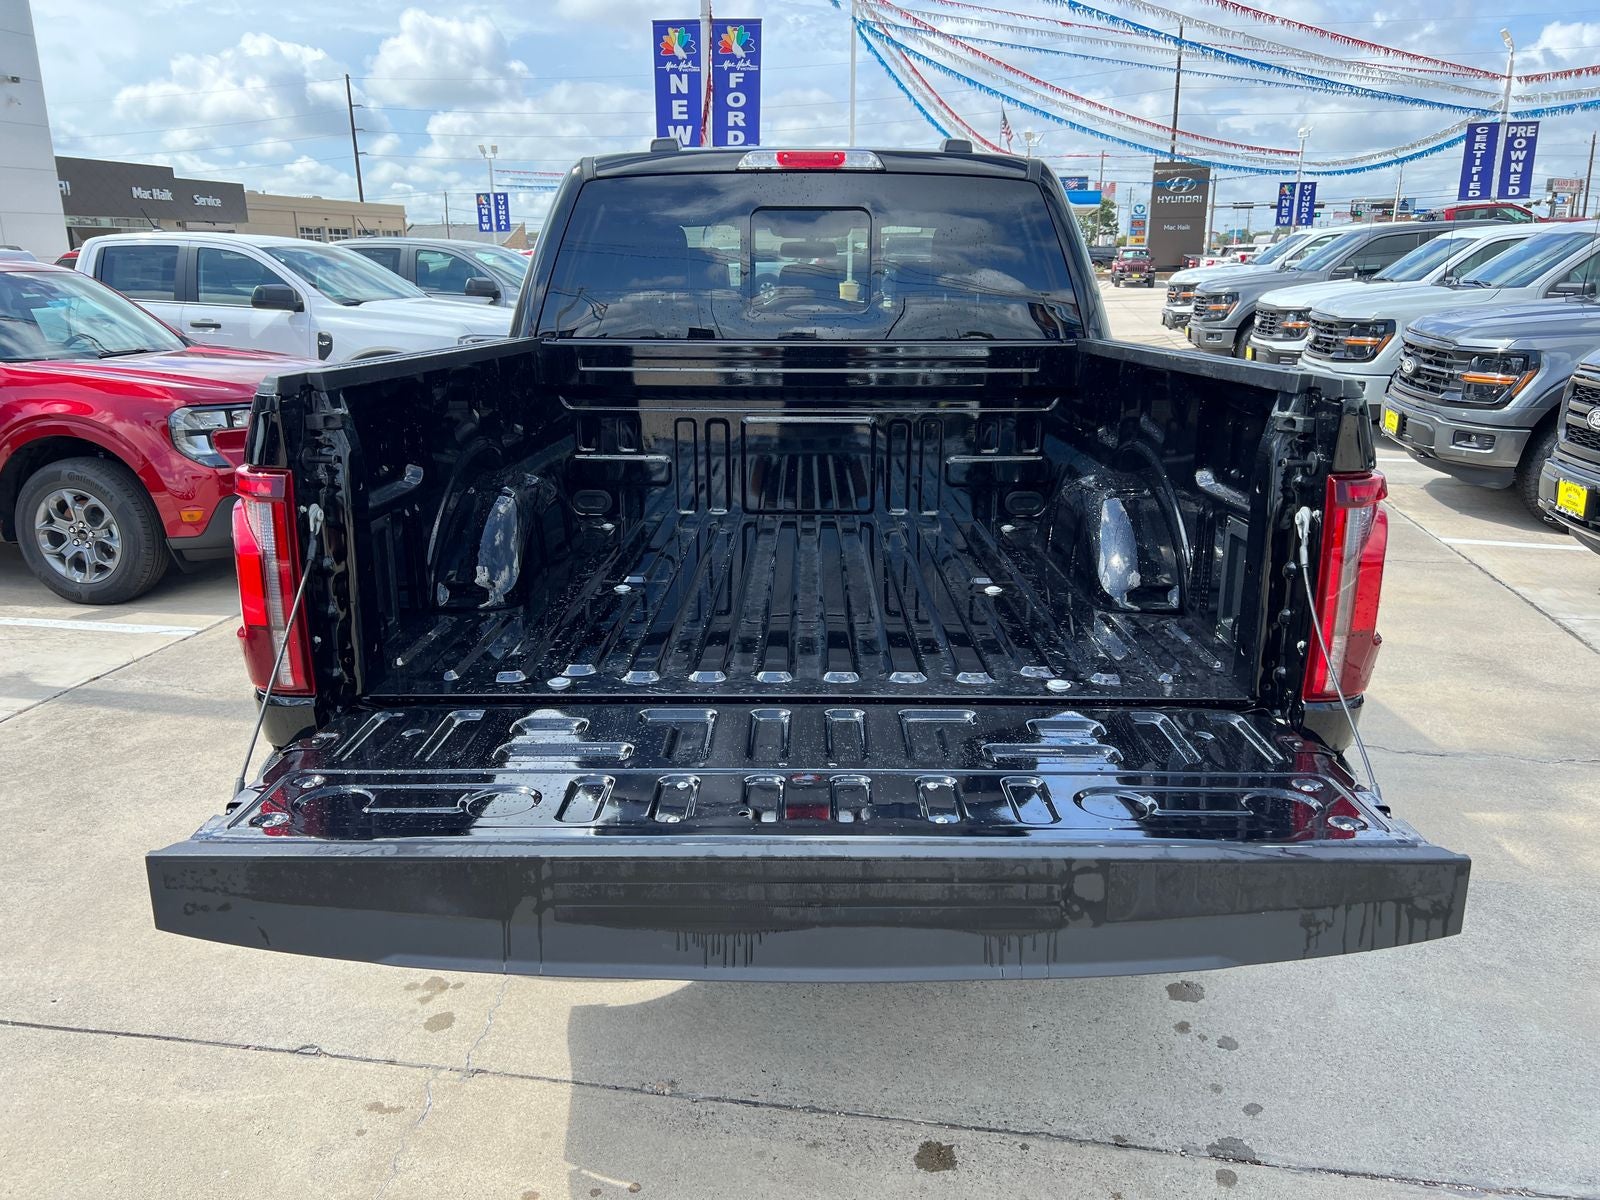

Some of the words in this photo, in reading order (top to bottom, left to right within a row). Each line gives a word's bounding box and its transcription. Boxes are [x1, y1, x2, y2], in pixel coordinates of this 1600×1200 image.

[668, 74, 692, 145] NEW
[726, 72, 746, 145] FORD
[1508, 125, 1536, 138] PRE
[1468, 126, 1489, 197] CERTIFIED
[1508, 138, 1526, 196] OWNED
[131, 186, 153, 199] Mac
[153, 188, 174, 201] Haik
[192, 194, 222, 207] Service
[1157, 195, 1202, 204] HYUNDAI
[1300, 184, 1312, 224] HYUNDAI
[481, 208, 490, 230] NEW
[497, 195, 506, 230] HYUNDAI
[1279, 199, 1290, 224] NEW
